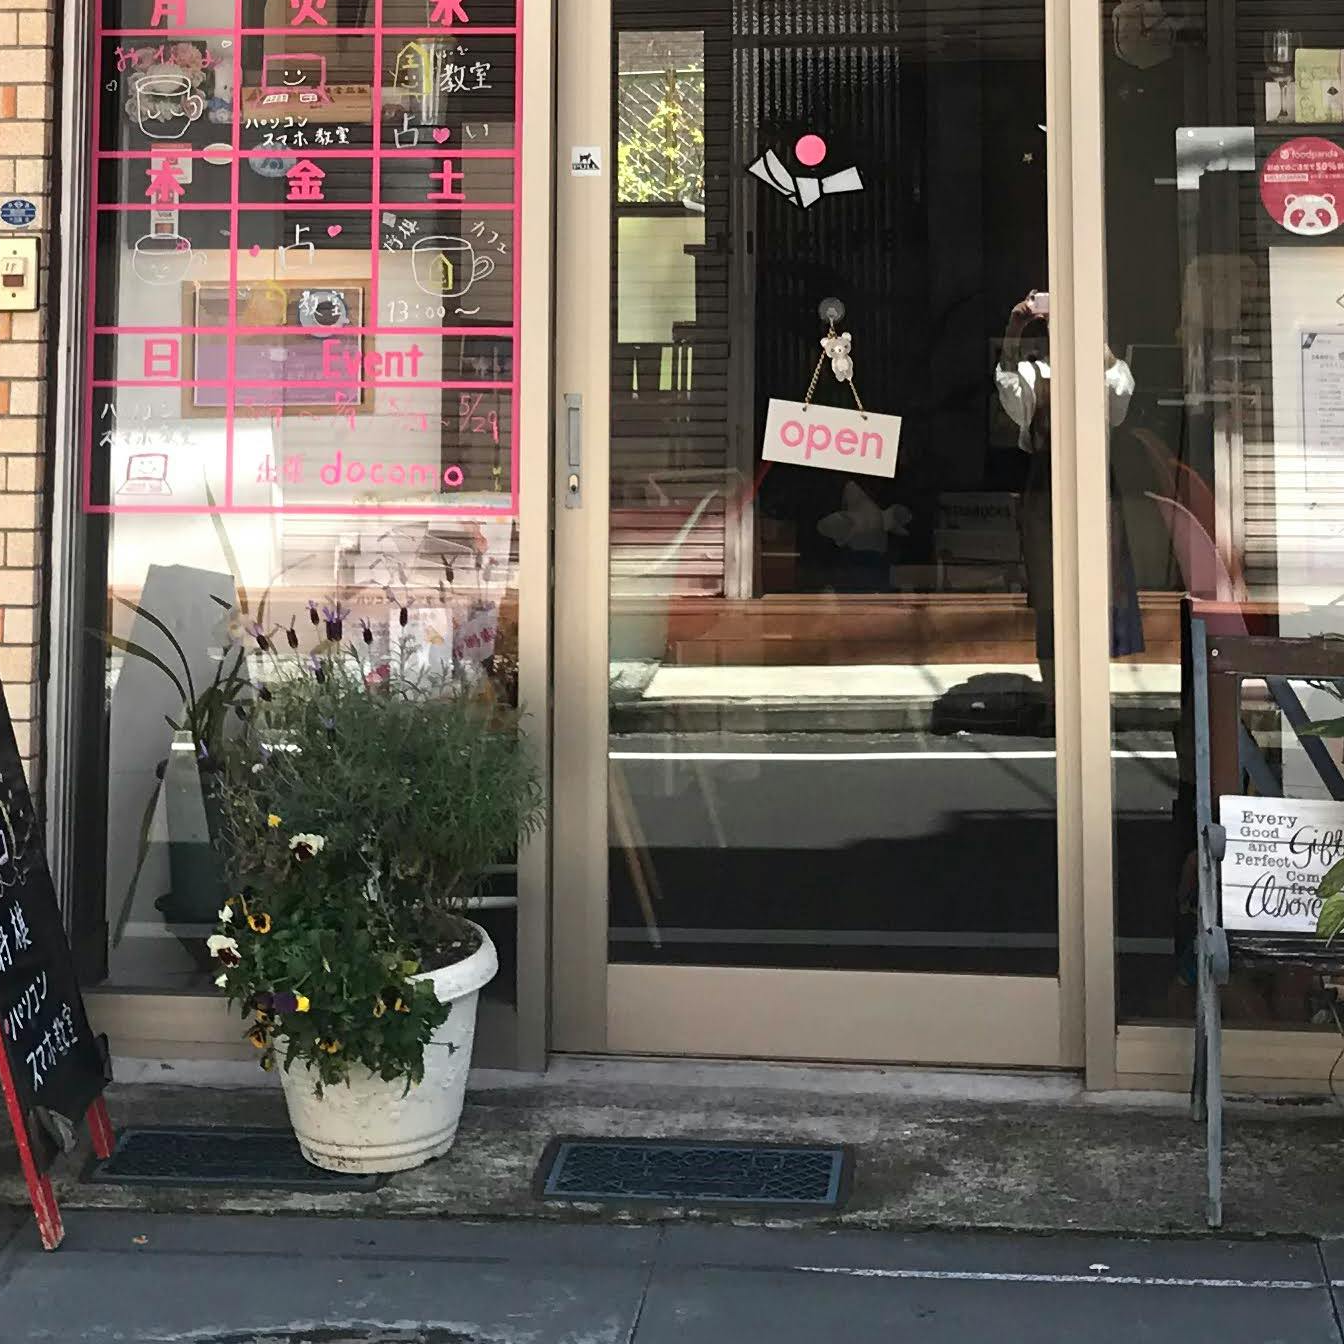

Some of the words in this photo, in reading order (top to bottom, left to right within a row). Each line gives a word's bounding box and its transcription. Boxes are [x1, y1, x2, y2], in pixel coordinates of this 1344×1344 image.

[440, 61, 493, 93] 教室
[145, 159, 186, 201] 木
[285, 159, 326, 200] 金
[426, 160, 466, 200] 土
[144, 339, 180, 378] 日
[321, 339, 425, 378] Event
[779, 420, 884, 460] open
[319, 449, 464, 487] docomo
[1240, 826, 1280, 839] Good
[1241, 810, 1298, 828] Every
[1235, 852, 1291, 869] Perfect
[1248, 842, 1278, 853] and
[1289, 825, 1344, 869] Gift
[1291, 882, 1318, 895] fro
